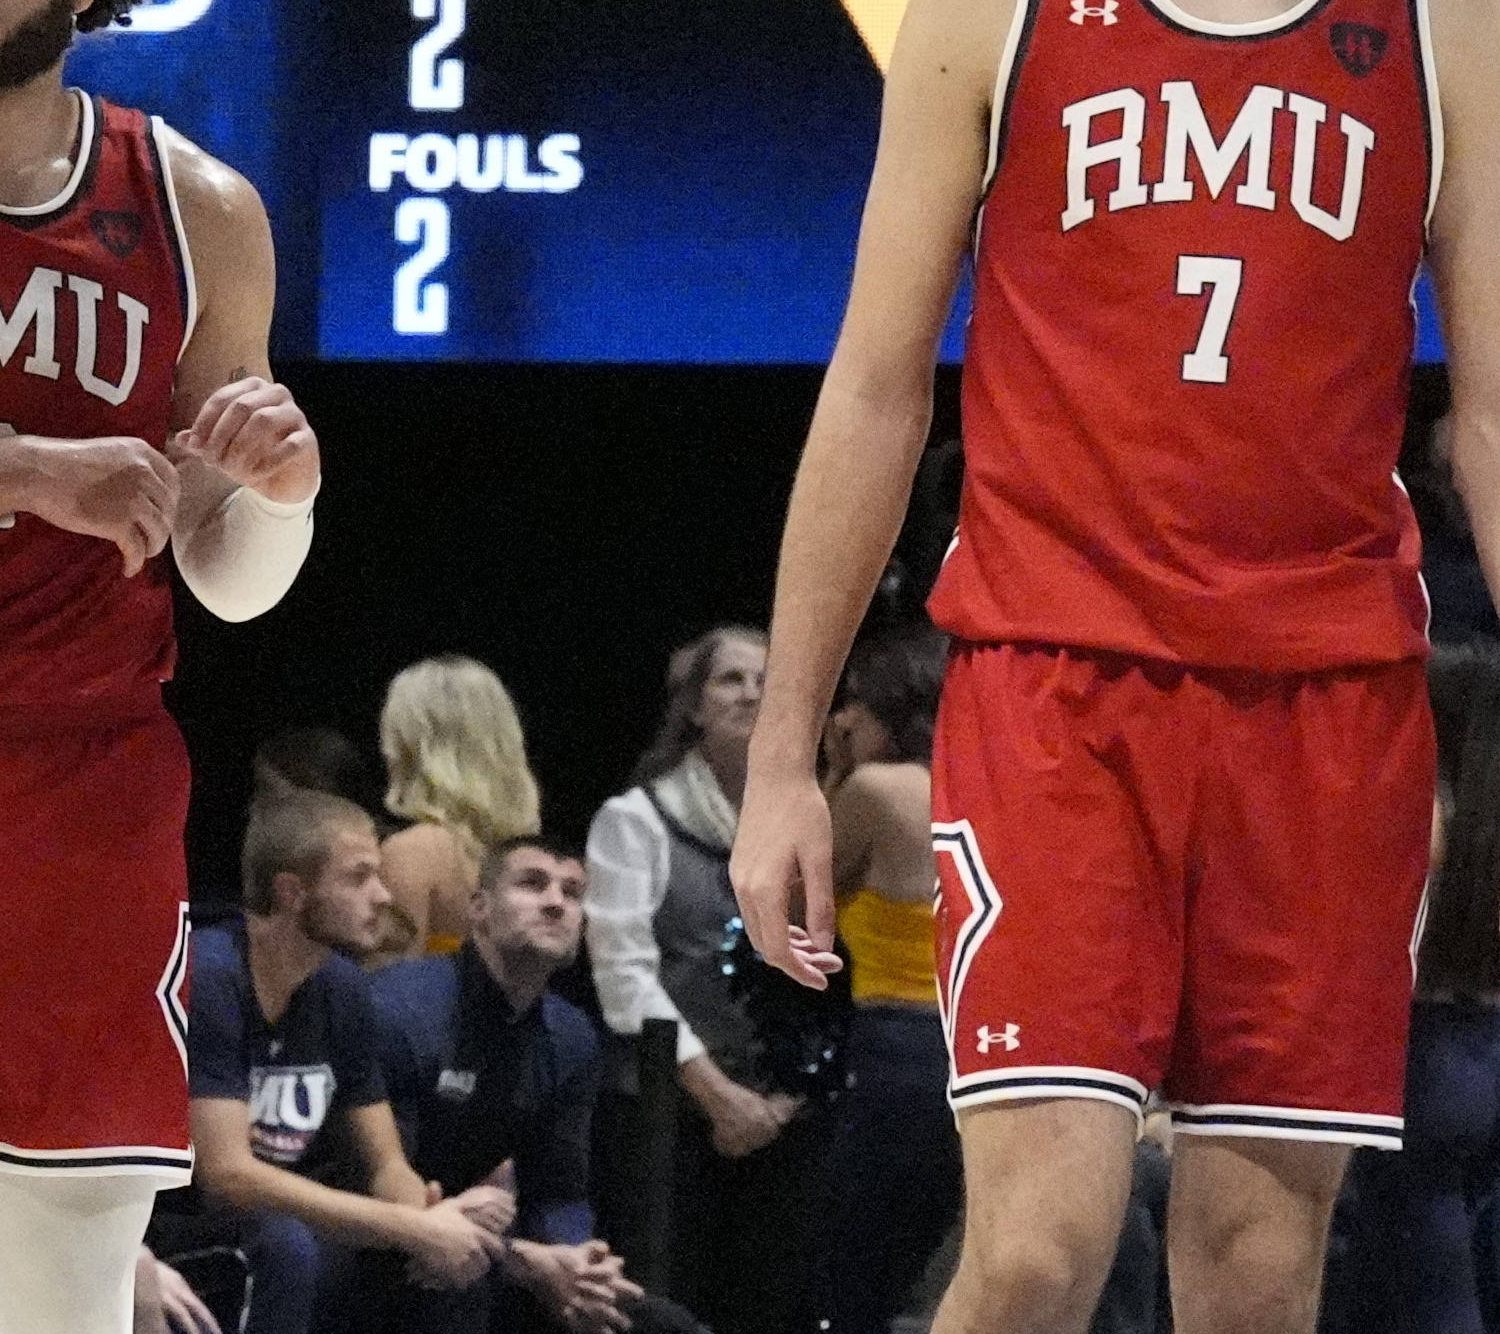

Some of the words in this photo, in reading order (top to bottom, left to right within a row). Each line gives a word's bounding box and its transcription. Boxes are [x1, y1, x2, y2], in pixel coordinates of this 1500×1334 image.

[368, 133, 584, 193] FOULS
[1061, 81, 1375, 242] RMU
[393, 196, 451, 335] 2
[1176, 255, 1242, 383] 7
